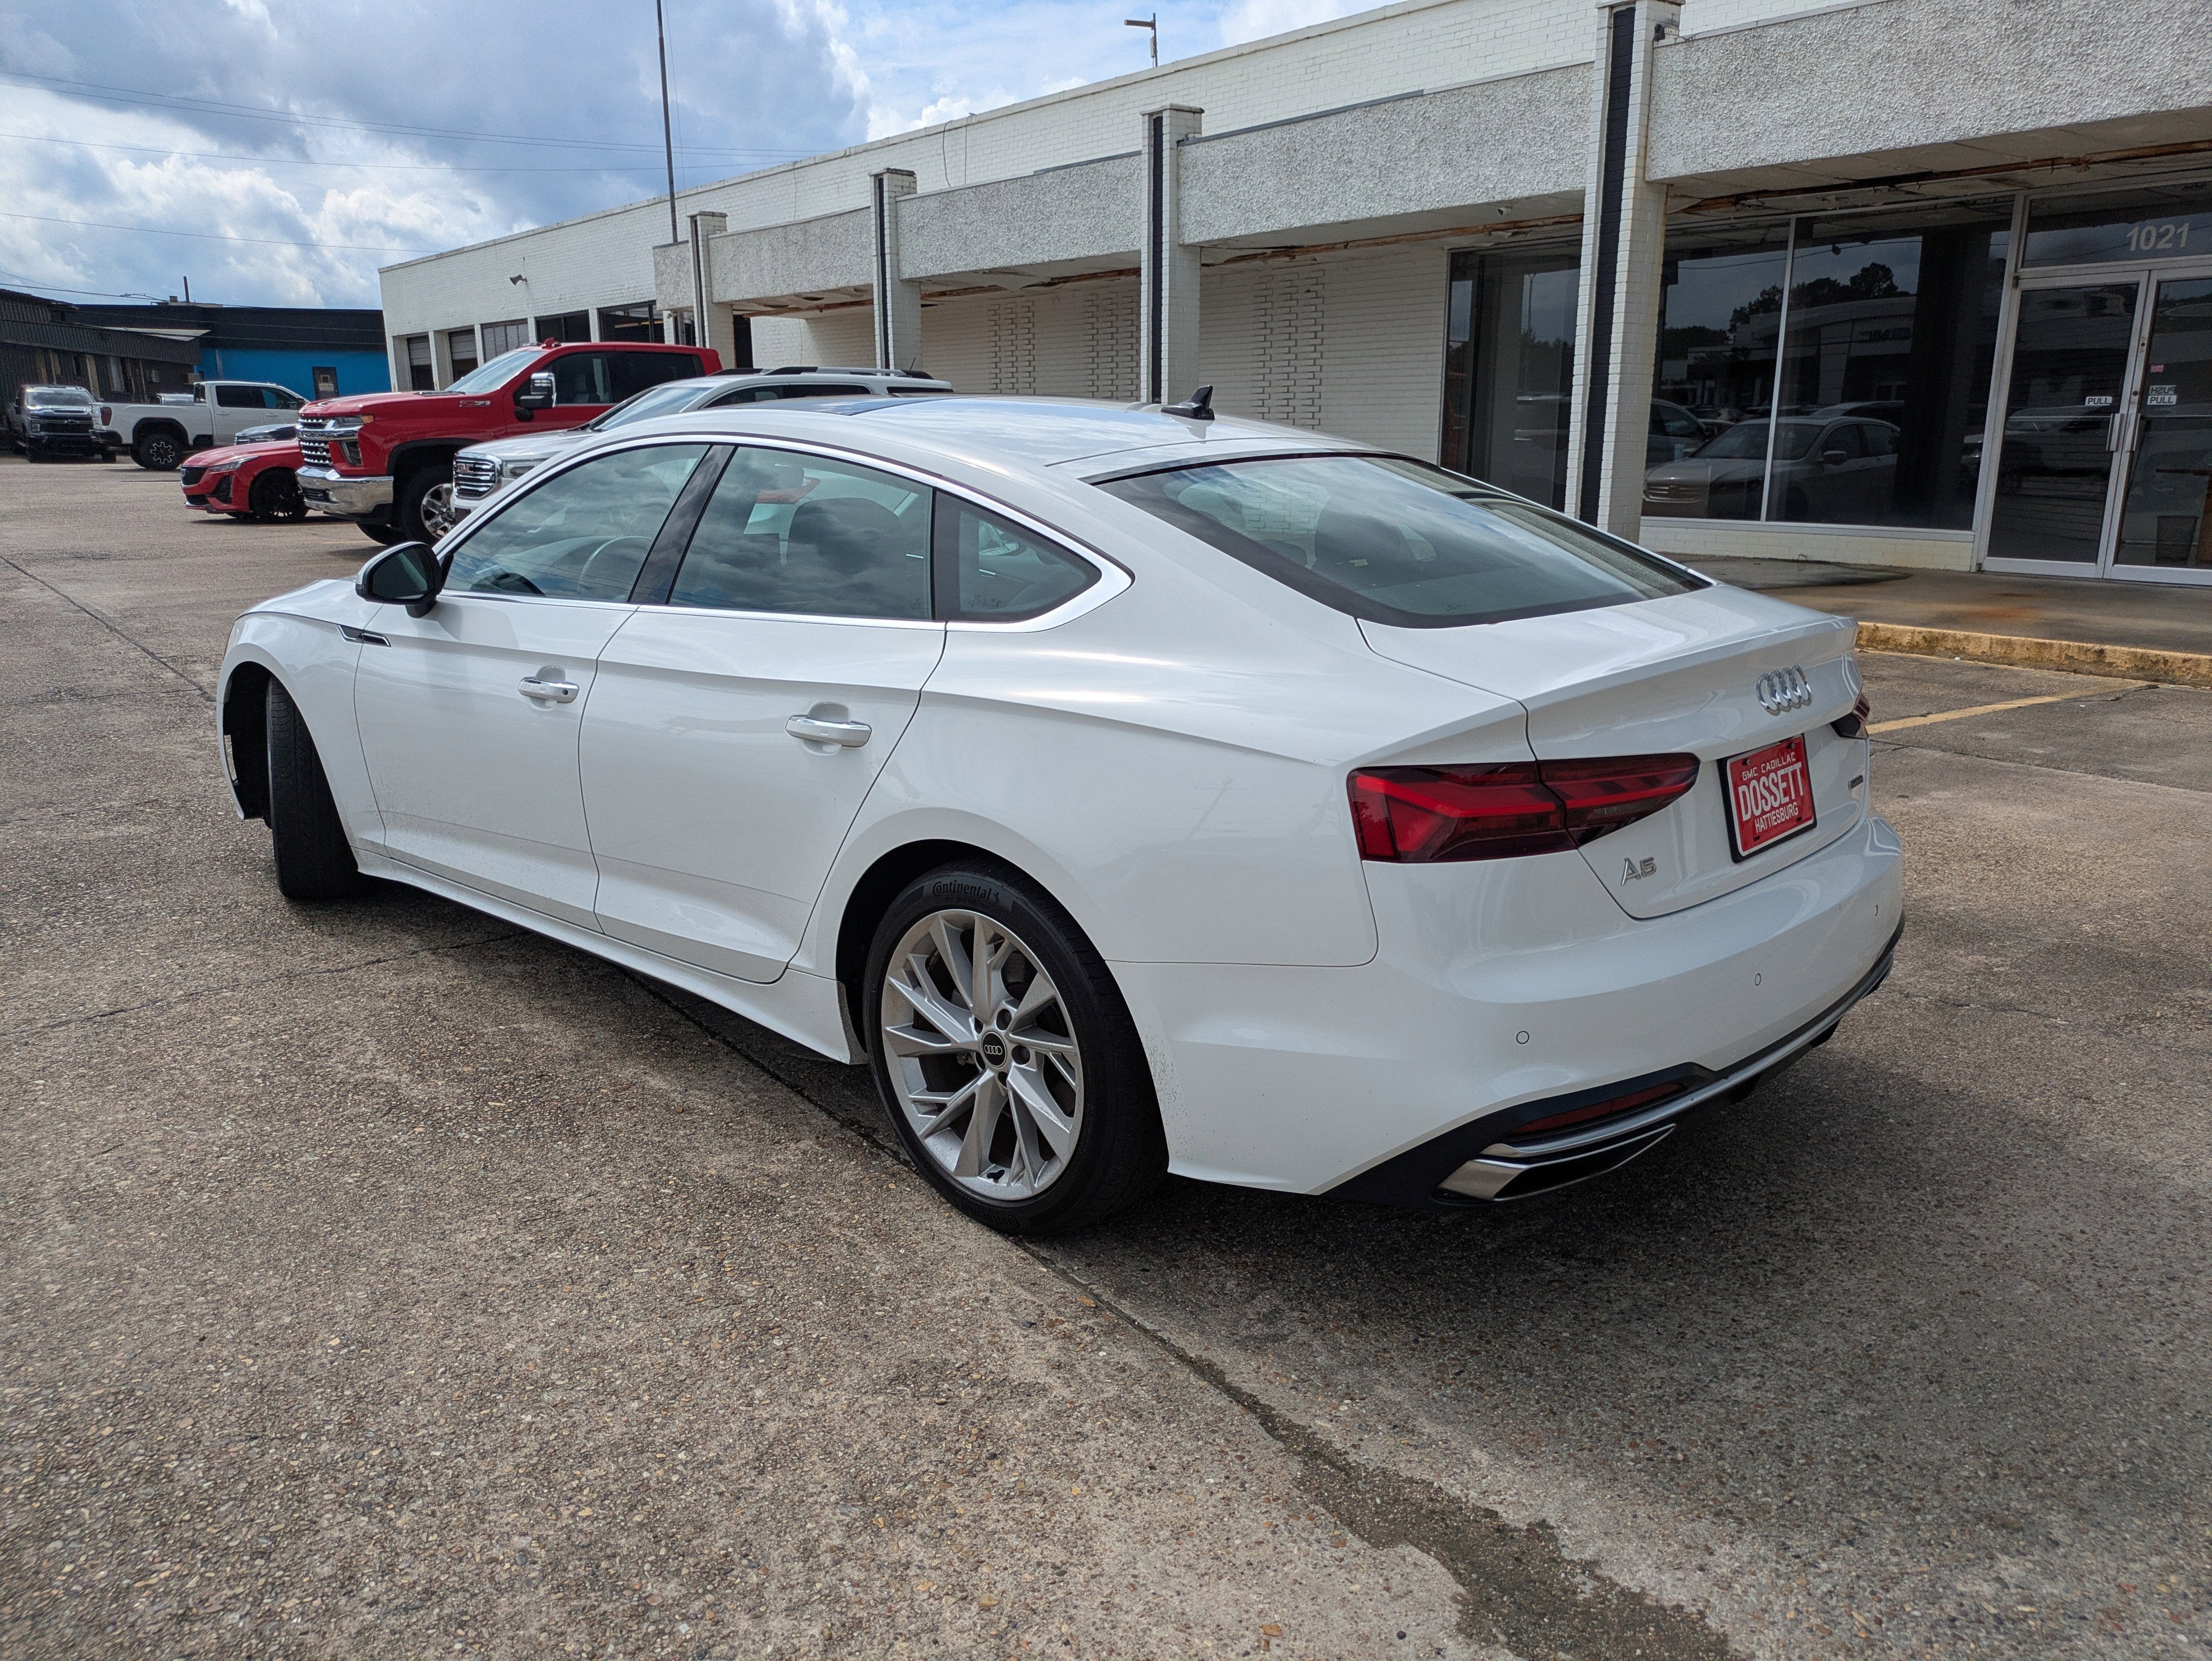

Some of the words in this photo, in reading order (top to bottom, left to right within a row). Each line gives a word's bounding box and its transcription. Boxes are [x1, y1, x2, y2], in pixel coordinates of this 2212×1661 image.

[2126, 222, 2190, 251] 1021
[1742, 766, 1758, 781] GMC
[1761, 752, 1796, 774] CADILLAC
[1738, 762, 1803, 821] DOSSETT
[1754, 801, 1799, 833] HATTIESBURG
[1620, 857, 1657, 886] A5
[932, 880, 992, 900] Continental
